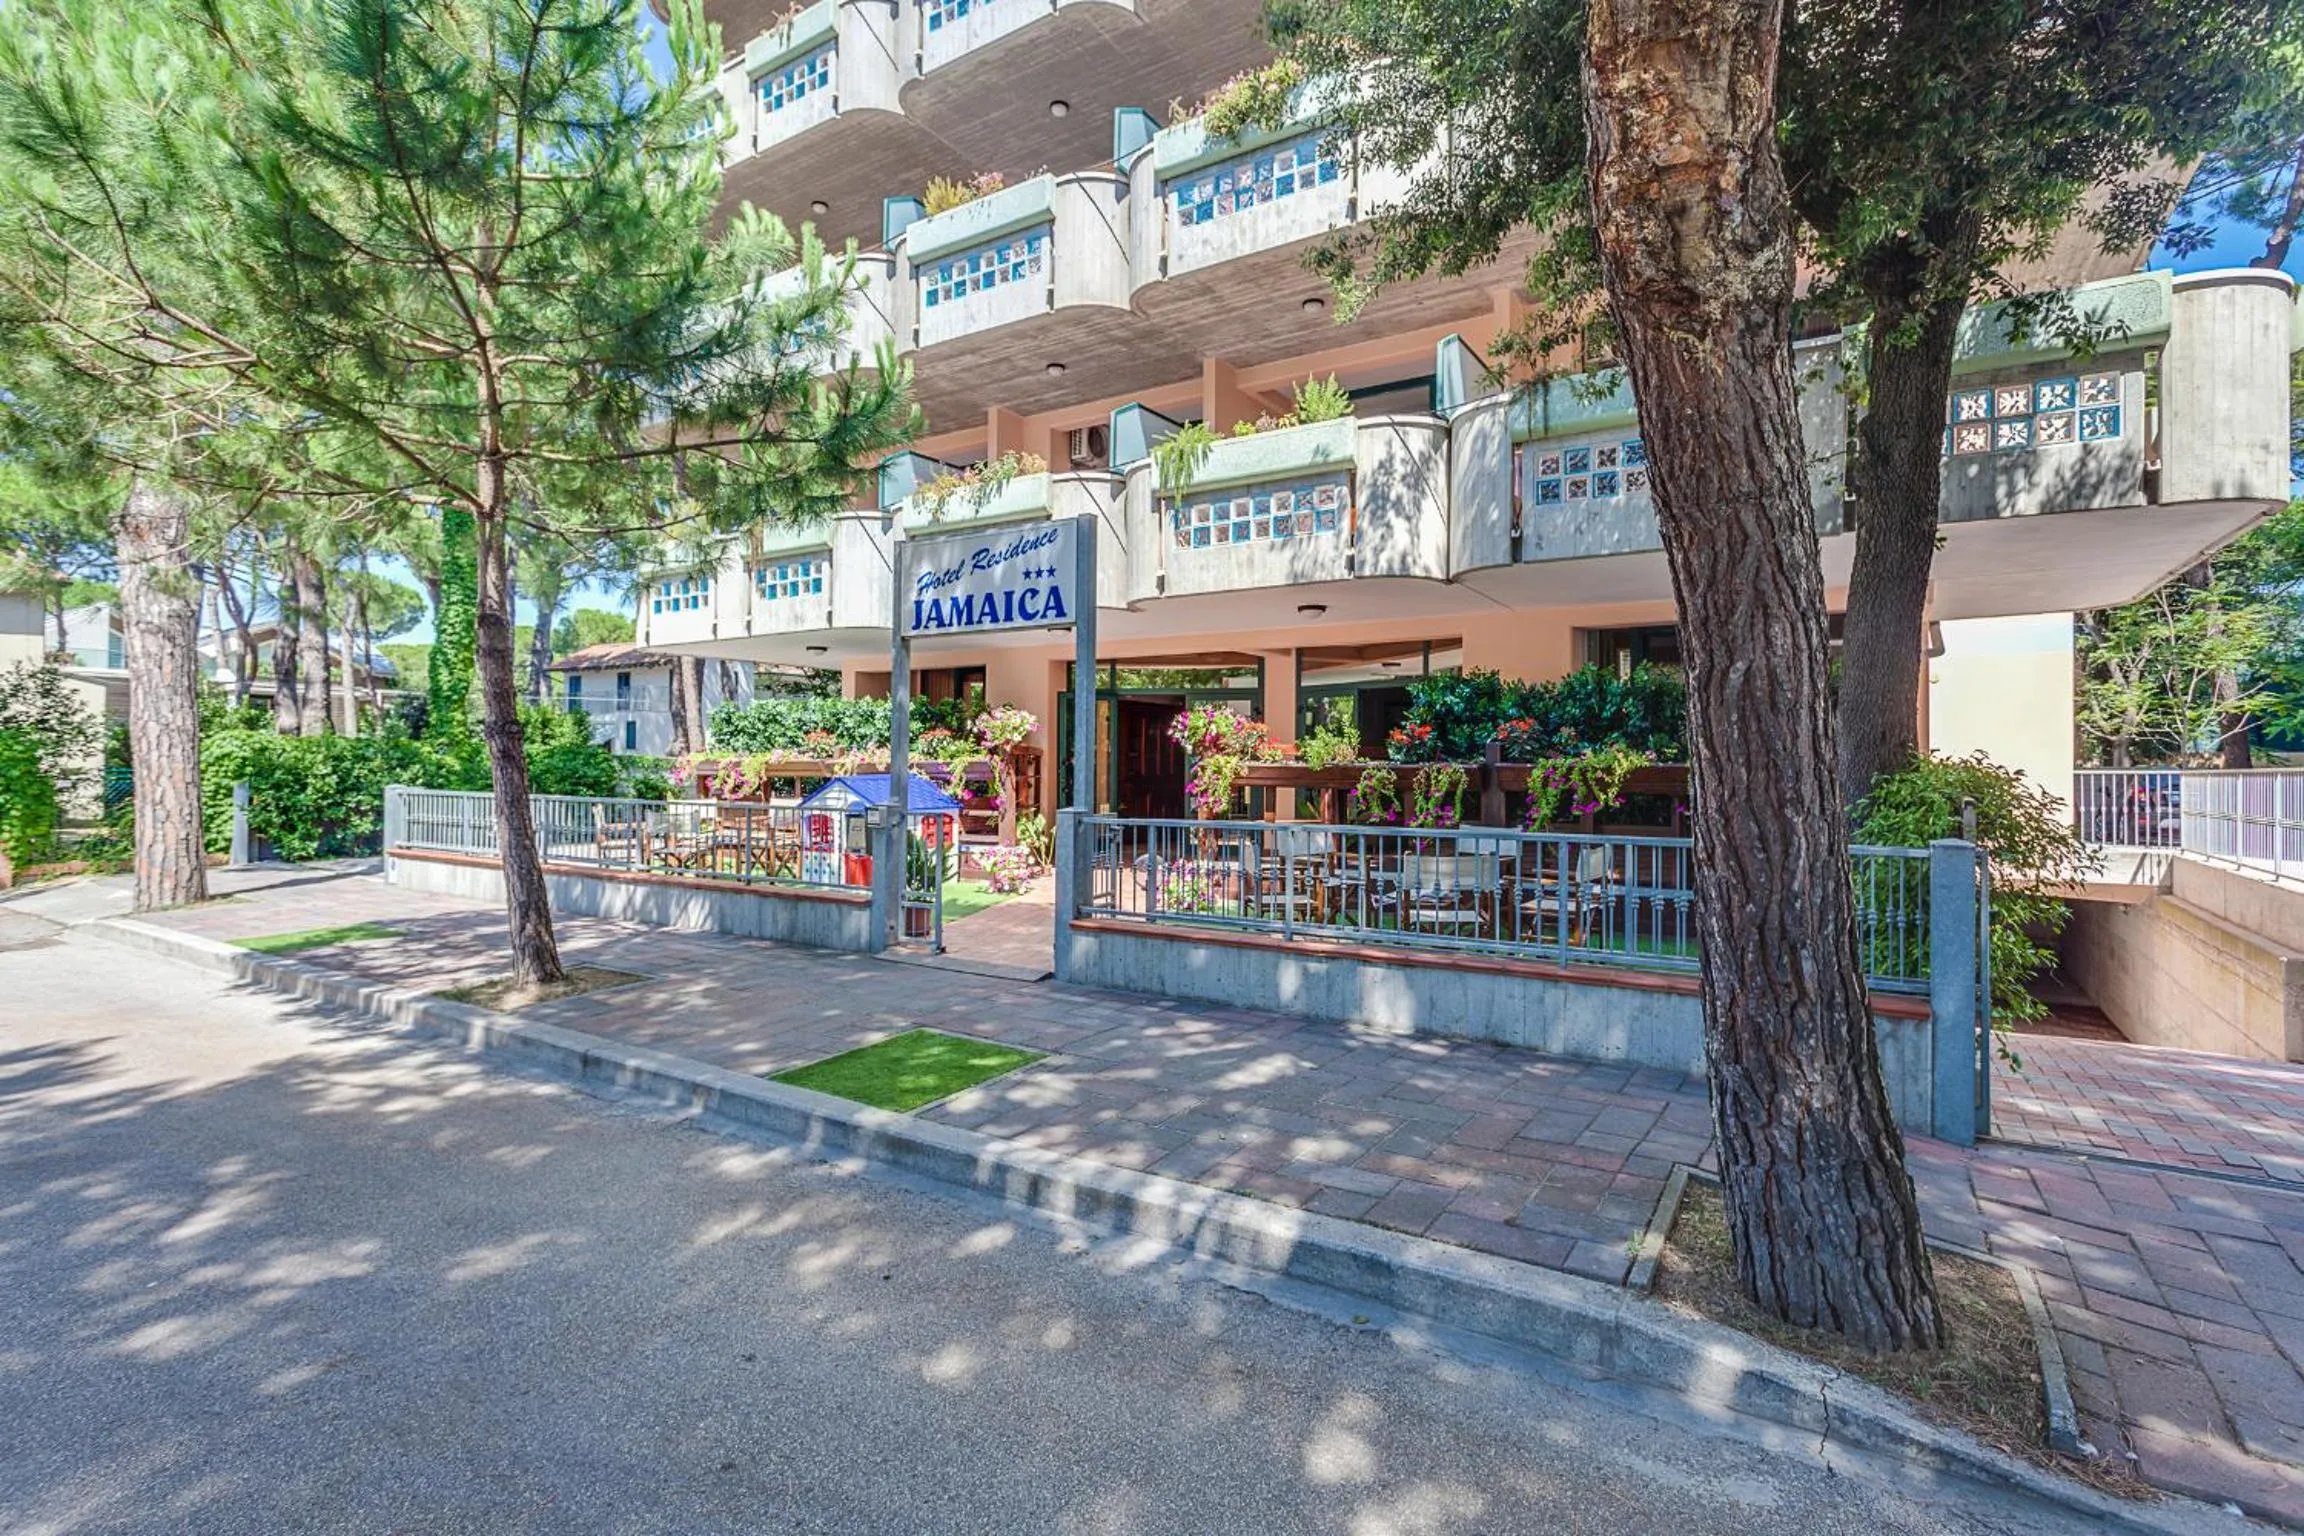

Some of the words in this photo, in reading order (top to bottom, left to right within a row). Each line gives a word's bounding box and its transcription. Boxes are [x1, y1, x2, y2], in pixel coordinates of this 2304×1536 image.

[916, 559, 966, 597] Hotel
[970, 527, 1059, 576] Residence
[911, 584, 1068, 631] JAMAICA
